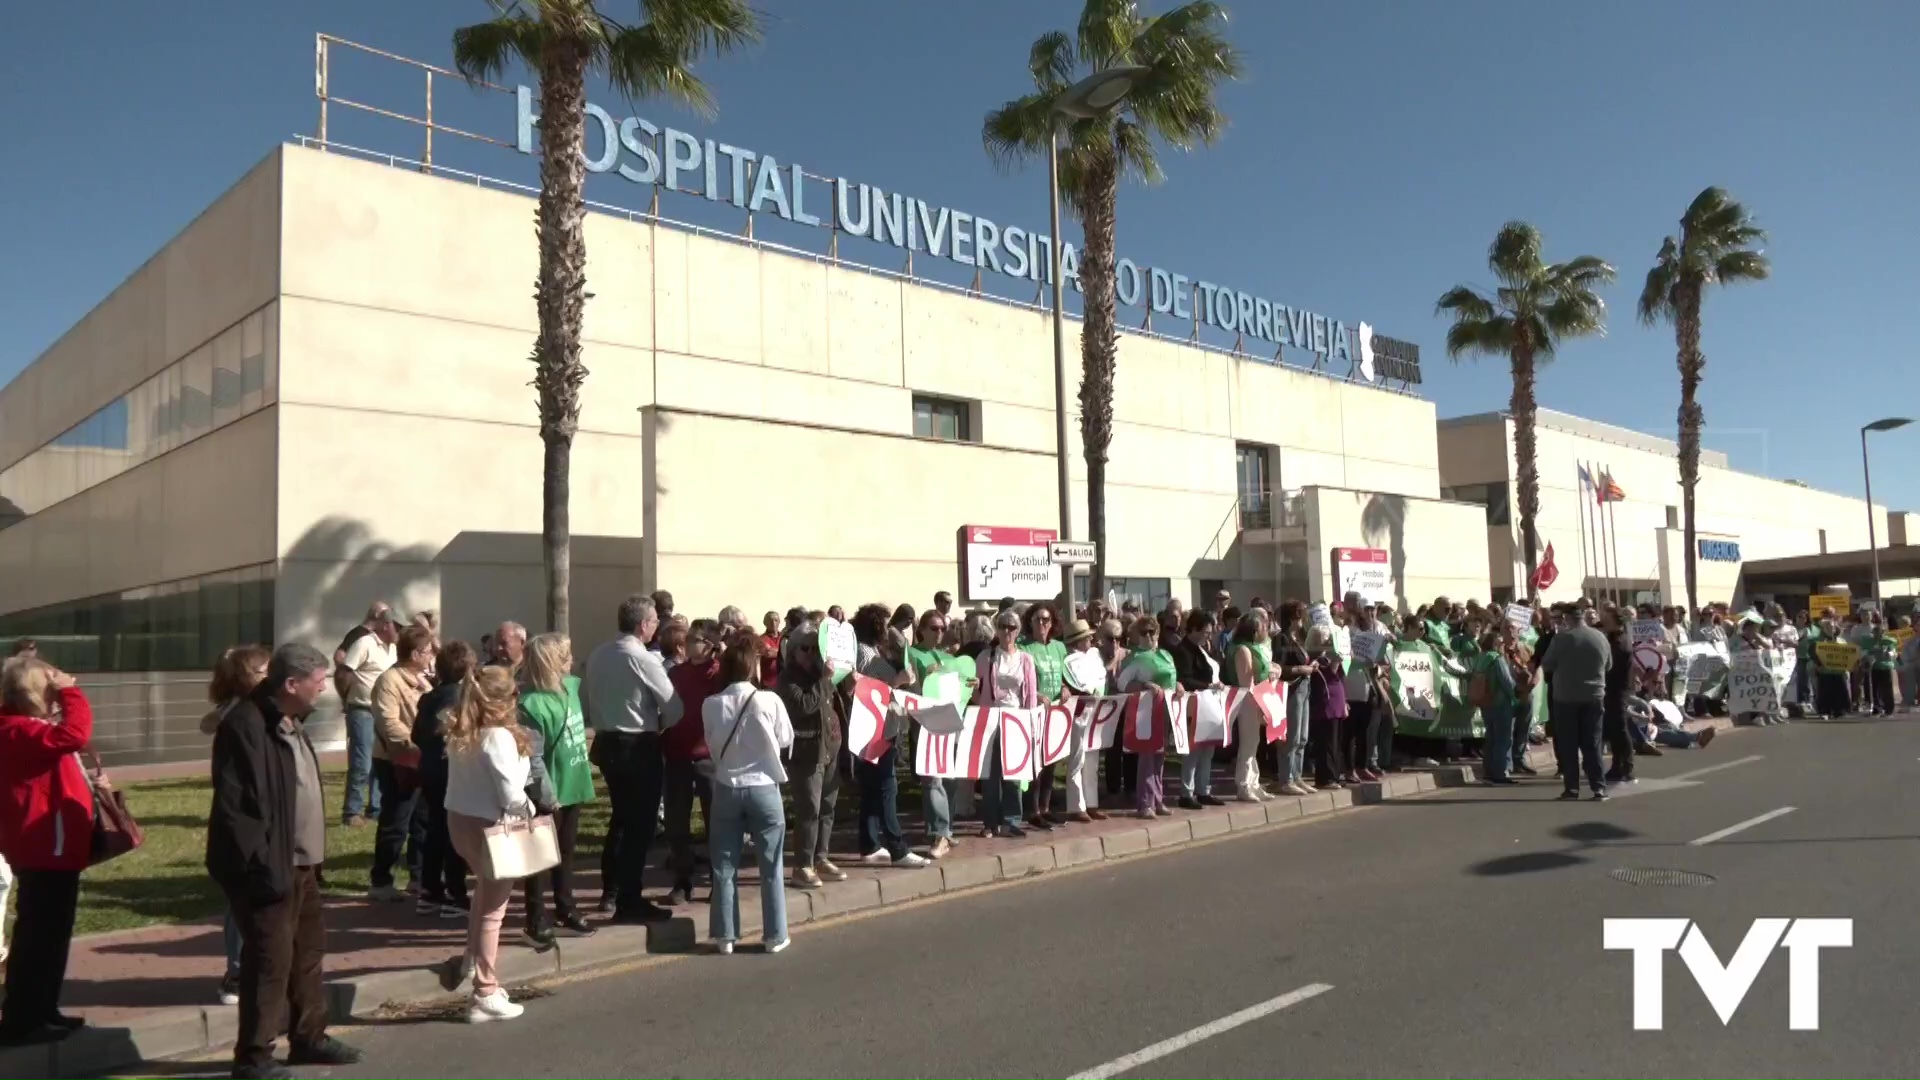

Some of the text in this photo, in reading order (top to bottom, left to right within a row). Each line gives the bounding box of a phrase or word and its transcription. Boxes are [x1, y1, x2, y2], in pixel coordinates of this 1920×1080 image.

[837, 176, 1141, 306] UNIVERSITAO
[1151, 267, 1191, 319] DE
[1198, 281, 1352, 361] TORREVIEJA
[1068, 550, 1094, 558] SALIDA
[1011, 569, 1049, 584] principal
